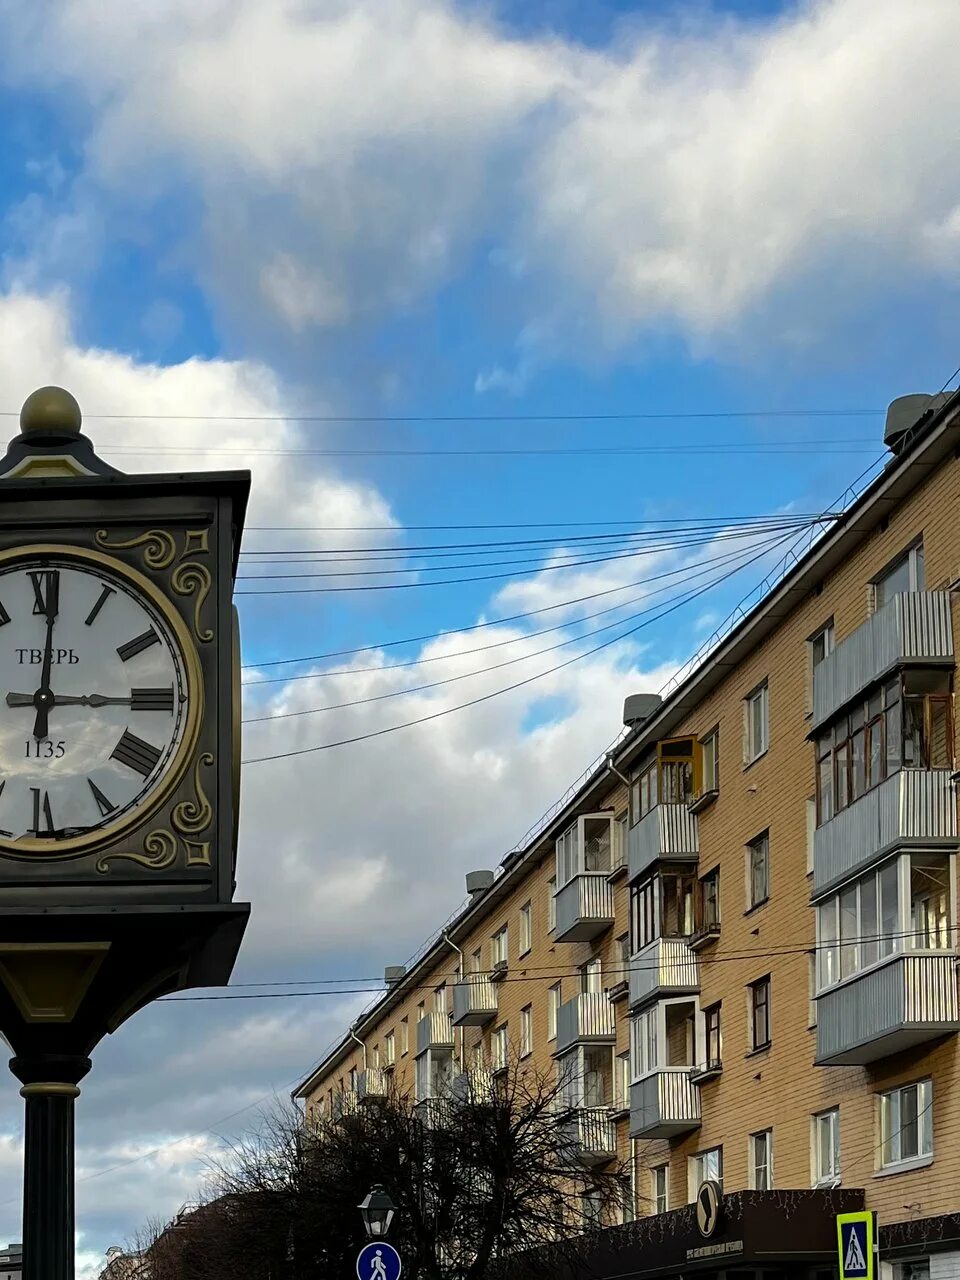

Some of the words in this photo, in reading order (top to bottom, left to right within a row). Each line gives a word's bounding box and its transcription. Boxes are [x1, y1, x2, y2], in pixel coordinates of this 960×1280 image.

[26, 570, 60, 615] XII
[85, 583, 117, 625] I
[15, 648, 79, 665] ТВЕРЬ
[116, 624, 162, 662] II
[25, 740, 65, 759] 1135
[87, 777, 120, 817] V
